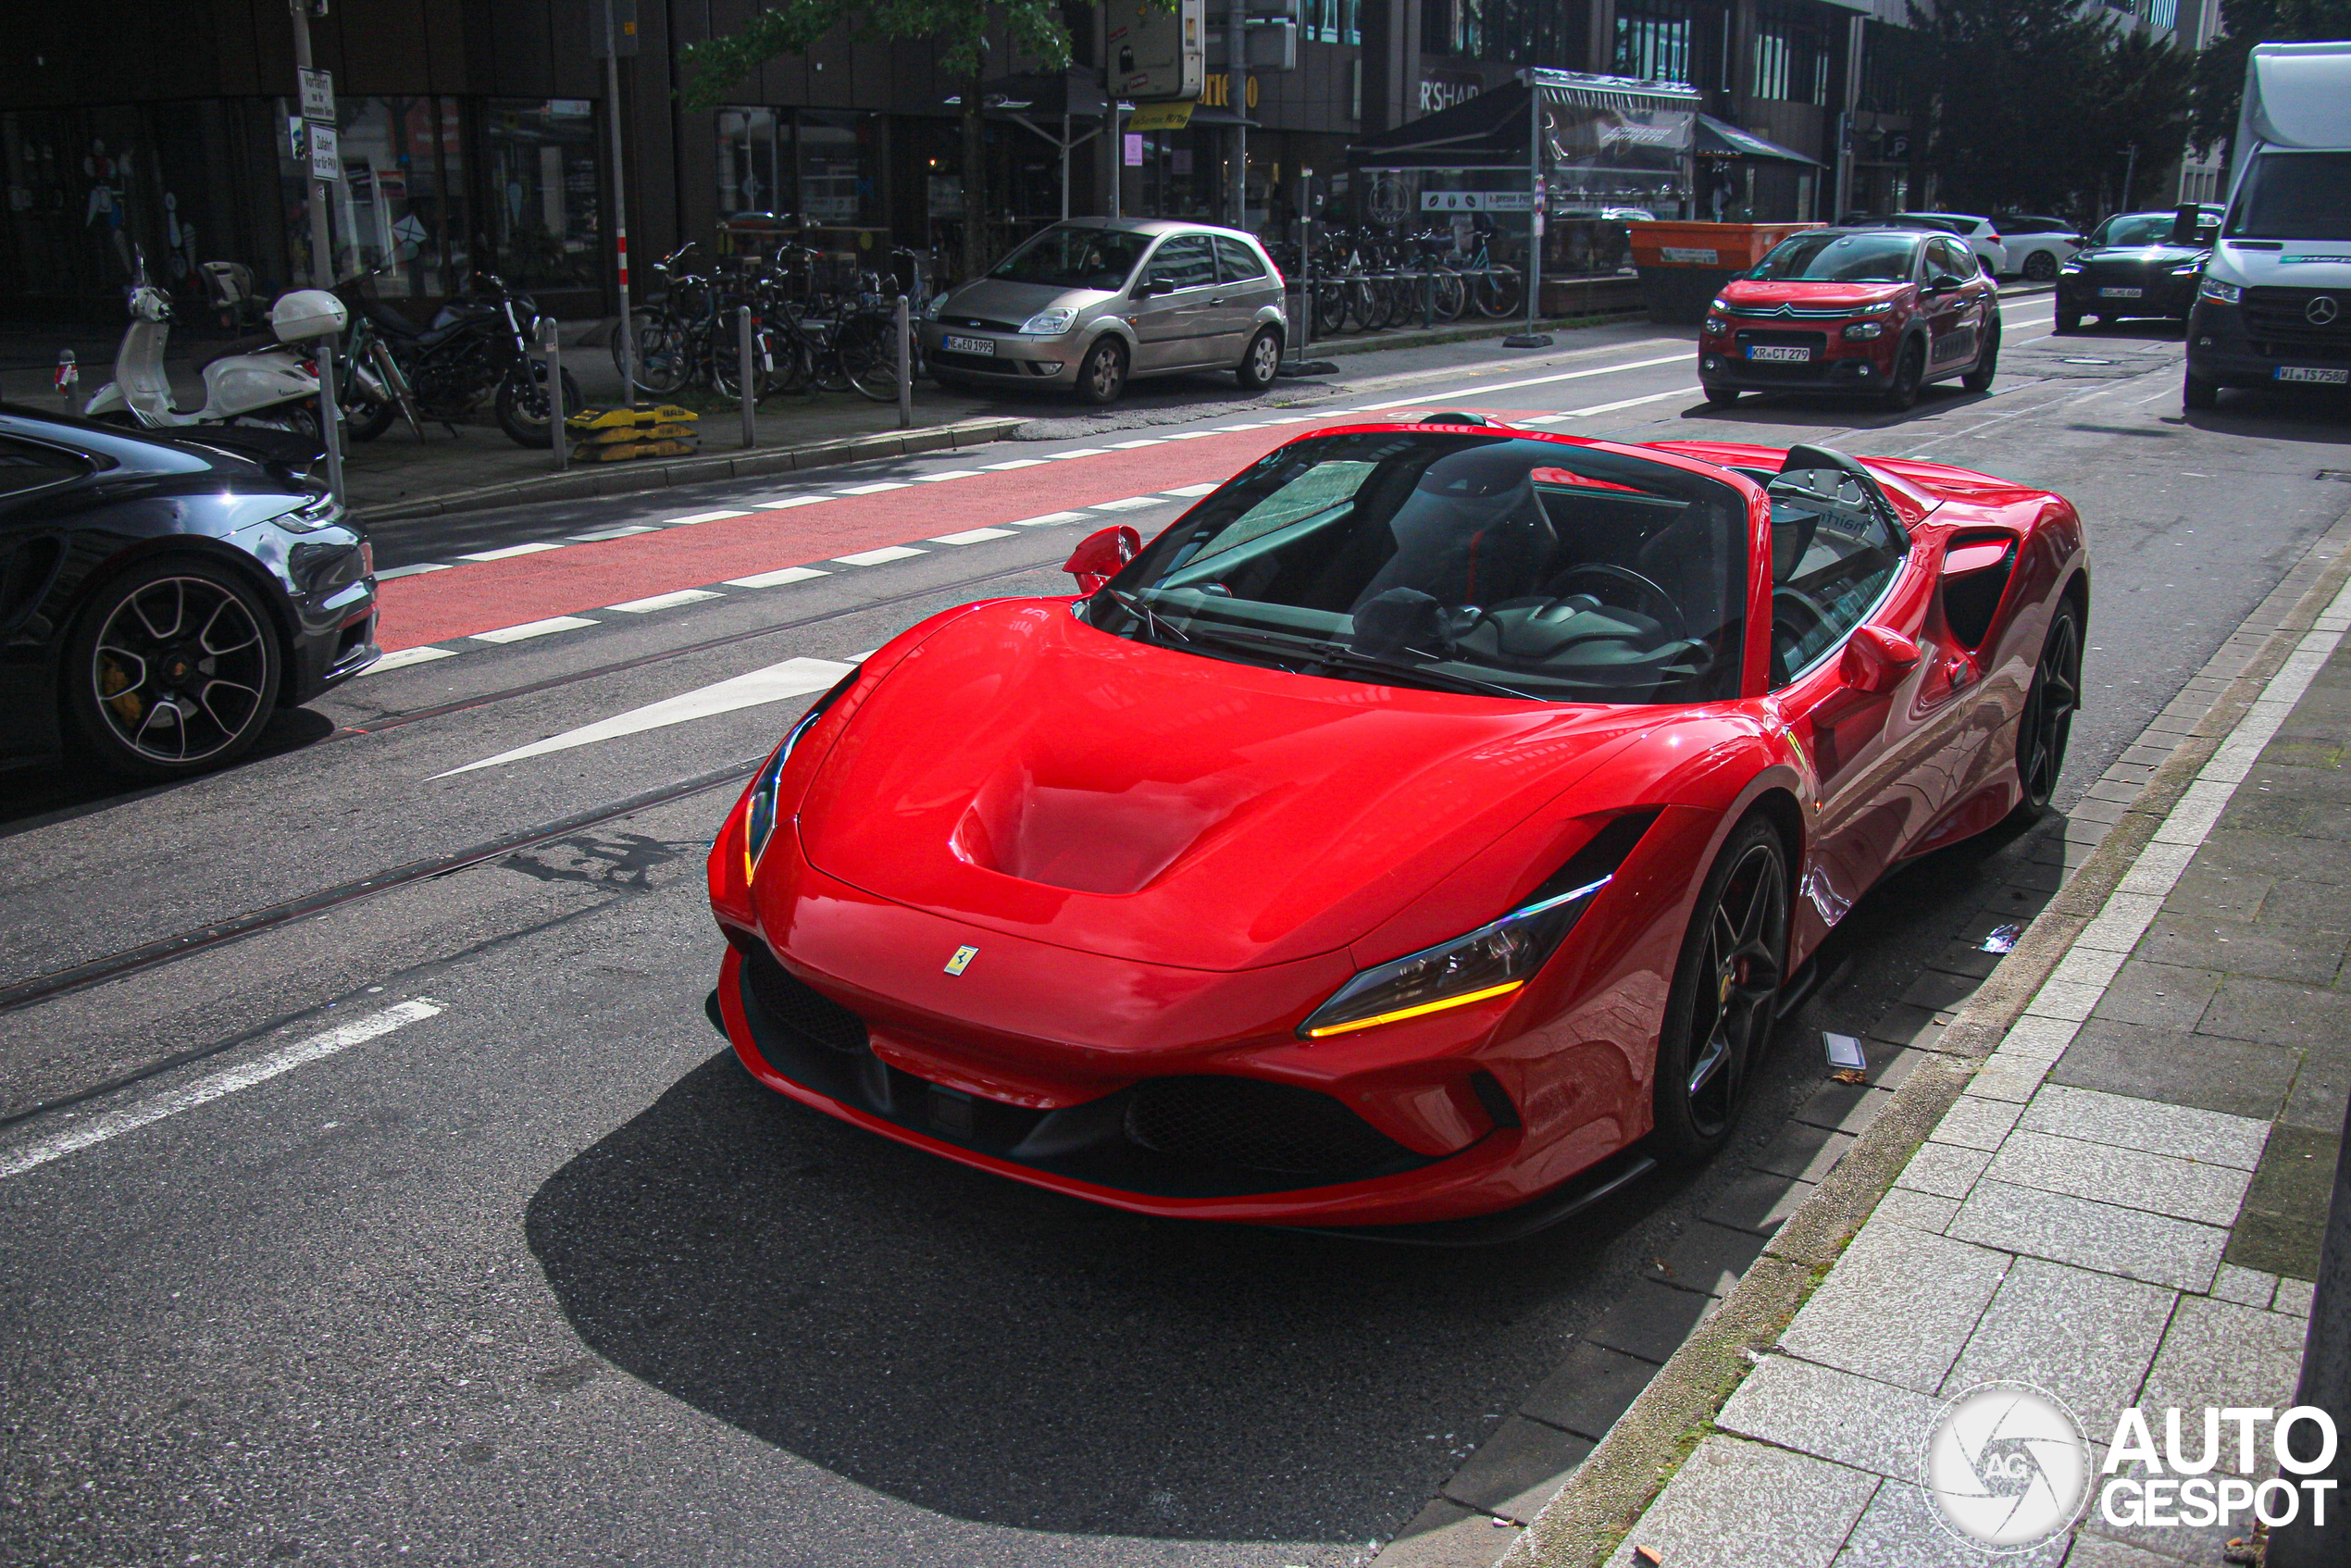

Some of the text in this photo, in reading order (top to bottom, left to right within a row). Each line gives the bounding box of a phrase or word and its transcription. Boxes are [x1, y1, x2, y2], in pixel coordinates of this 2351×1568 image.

[305, 73, 329, 90] Vorfahrt
[317, 134, 333, 152] Zufahrt
[948, 338, 957, 348] NE
[1752, 347, 1809, 360] KR CT 279
